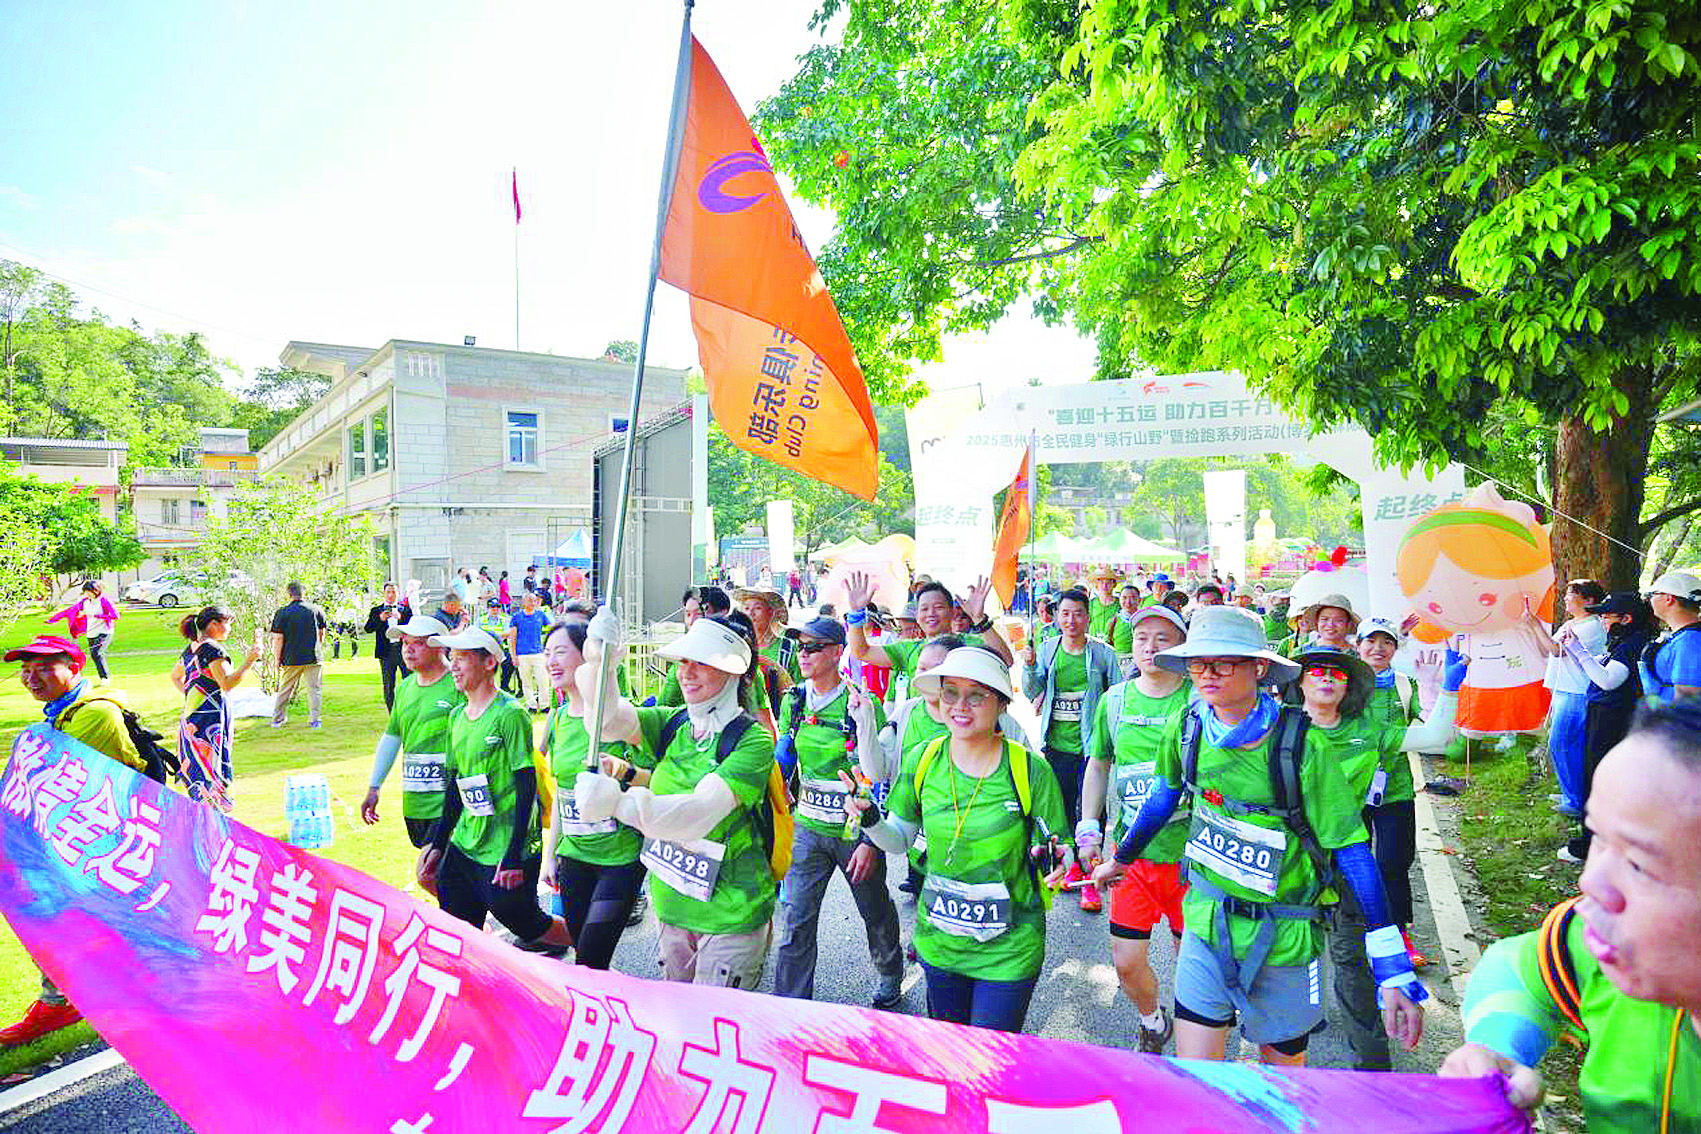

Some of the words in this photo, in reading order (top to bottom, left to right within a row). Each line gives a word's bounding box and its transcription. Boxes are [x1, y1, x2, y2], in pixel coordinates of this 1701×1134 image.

[917, 504, 982, 526] 起终点
[800, 789, 841, 808] A0286
[649, 839, 709, 878] A0298
[1197, 826, 1271, 869] A0280
[932, 895, 999, 921] A0291
